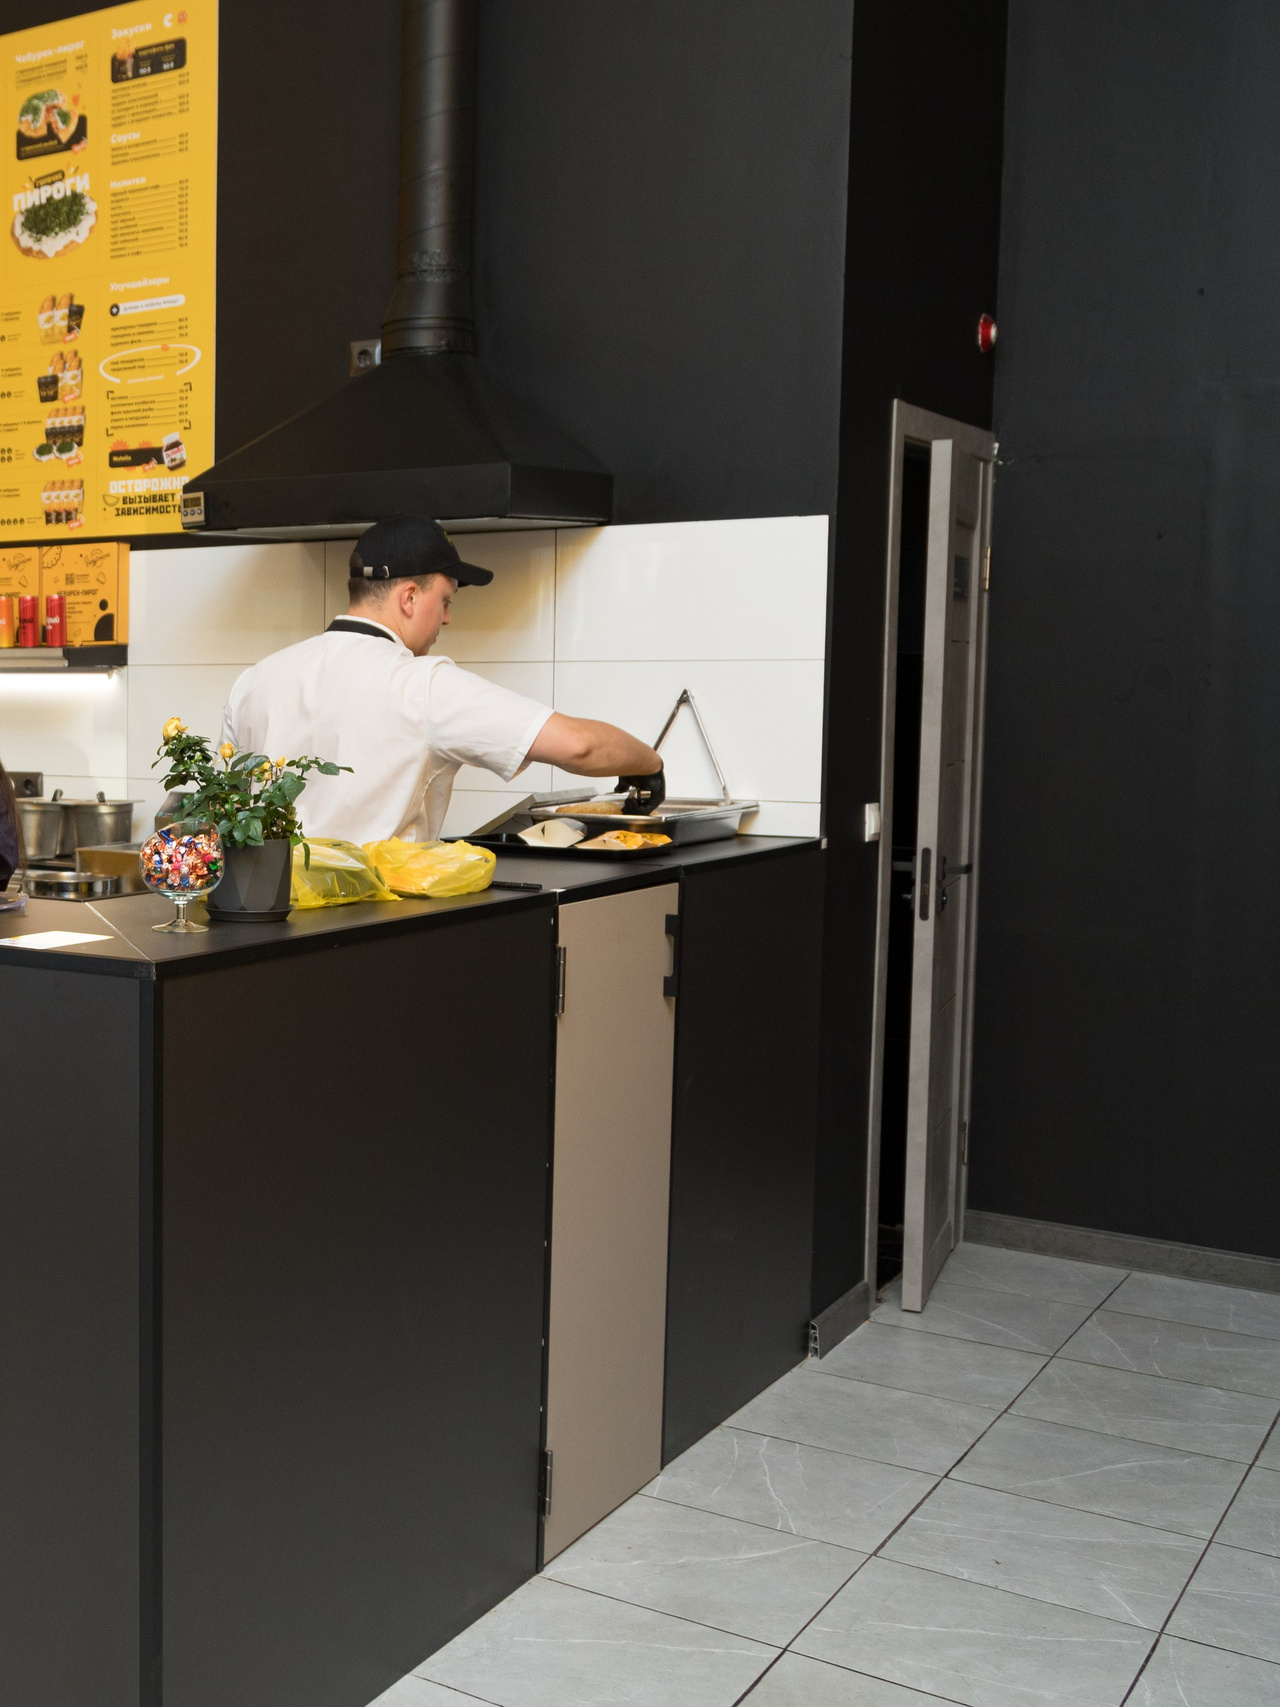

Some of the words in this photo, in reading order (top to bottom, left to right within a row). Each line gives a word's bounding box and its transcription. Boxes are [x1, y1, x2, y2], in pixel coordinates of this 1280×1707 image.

[111, 22, 152, 40] Закуски
[110, 131, 140, 144] Соусы
[110, 176, 146, 190] Напитки
[13, 172, 90, 212] ПИРОГИ
[110, 276, 170, 292] Улучшайзеры
[112, 454, 132, 462] Nutella
[122, 492, 176, 505] ВЫЗЫВАЕТ
